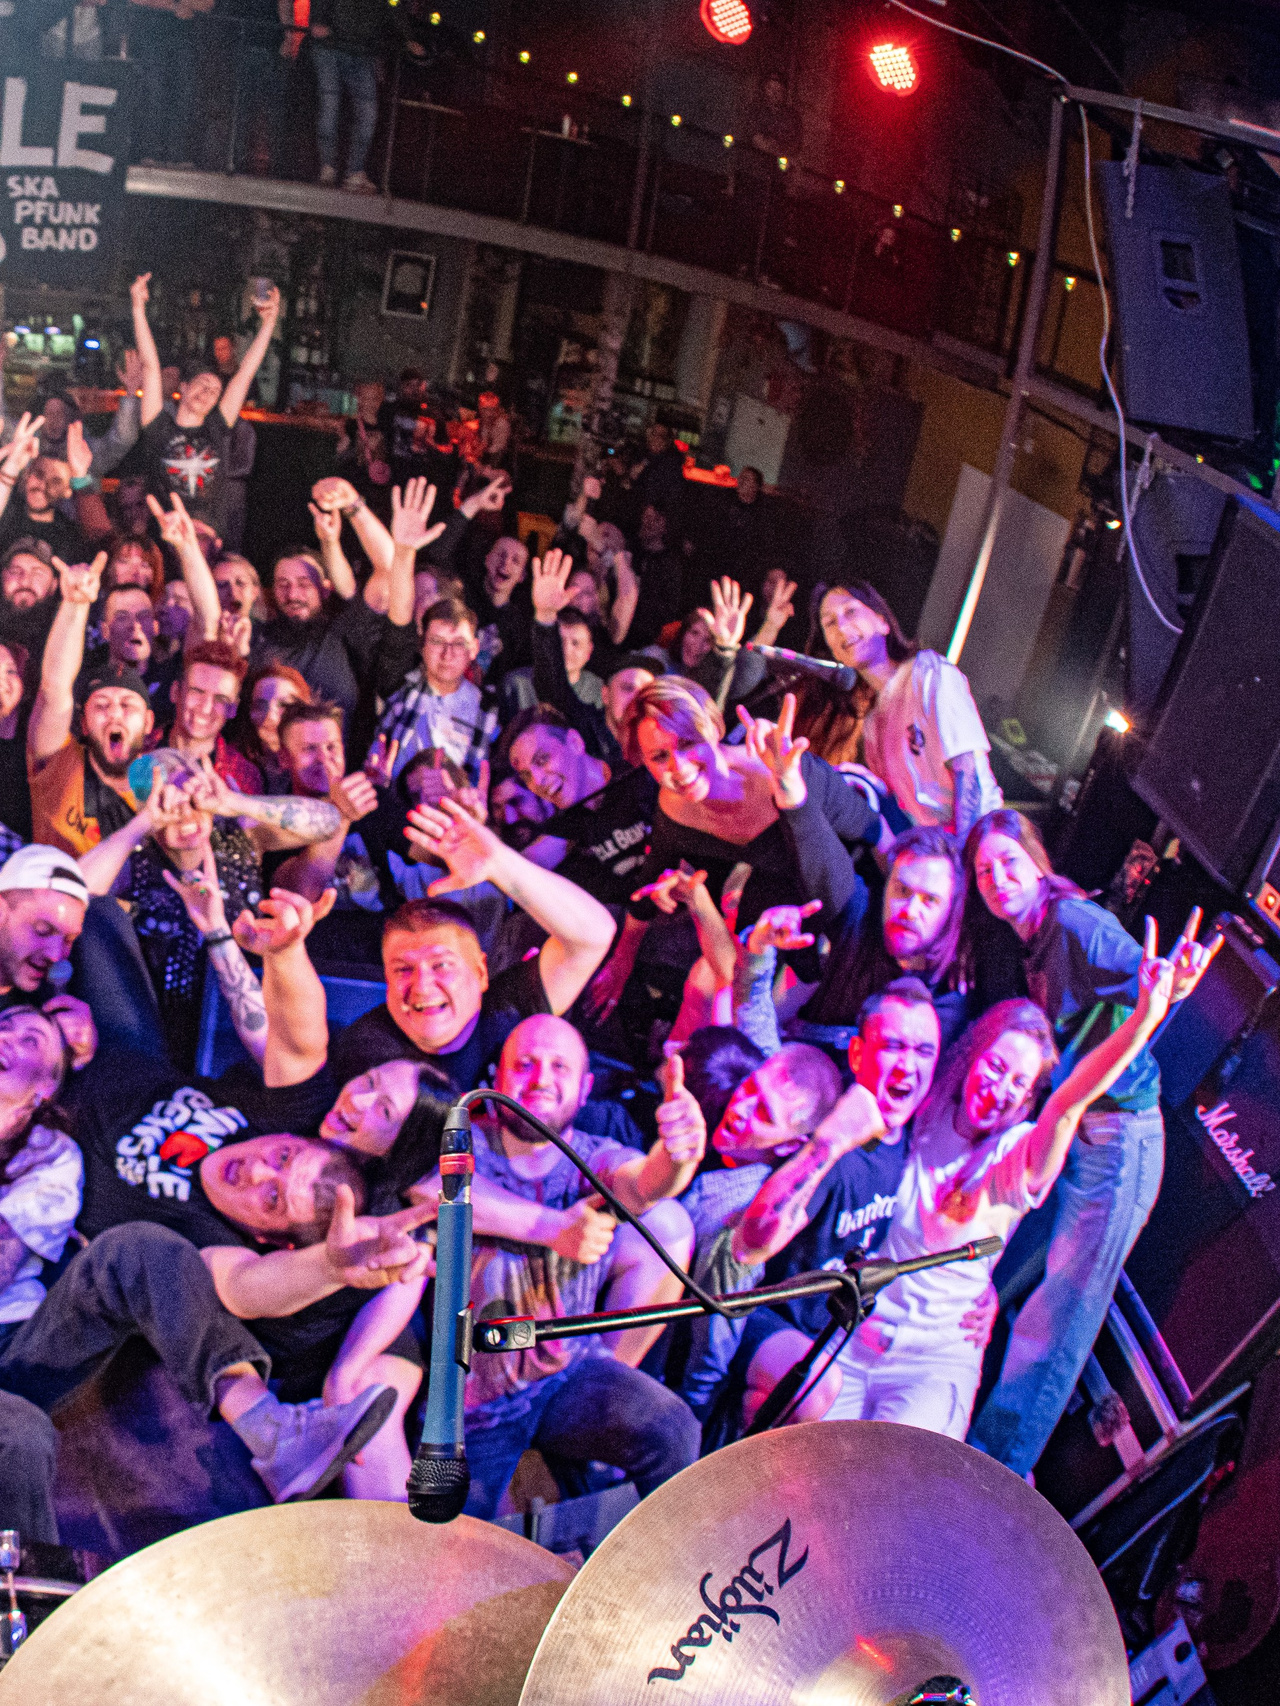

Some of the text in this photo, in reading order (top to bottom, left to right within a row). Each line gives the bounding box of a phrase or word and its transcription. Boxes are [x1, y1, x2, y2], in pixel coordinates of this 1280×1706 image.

[8, 175, 60, 200] SKA
[14, 200, 101, 224] PFUNK
[21, 227, 98, 251] BAND
[1194, 1101, 1276, 1198] Marshall
[647, 1516, 809, 1685] Zildjian
